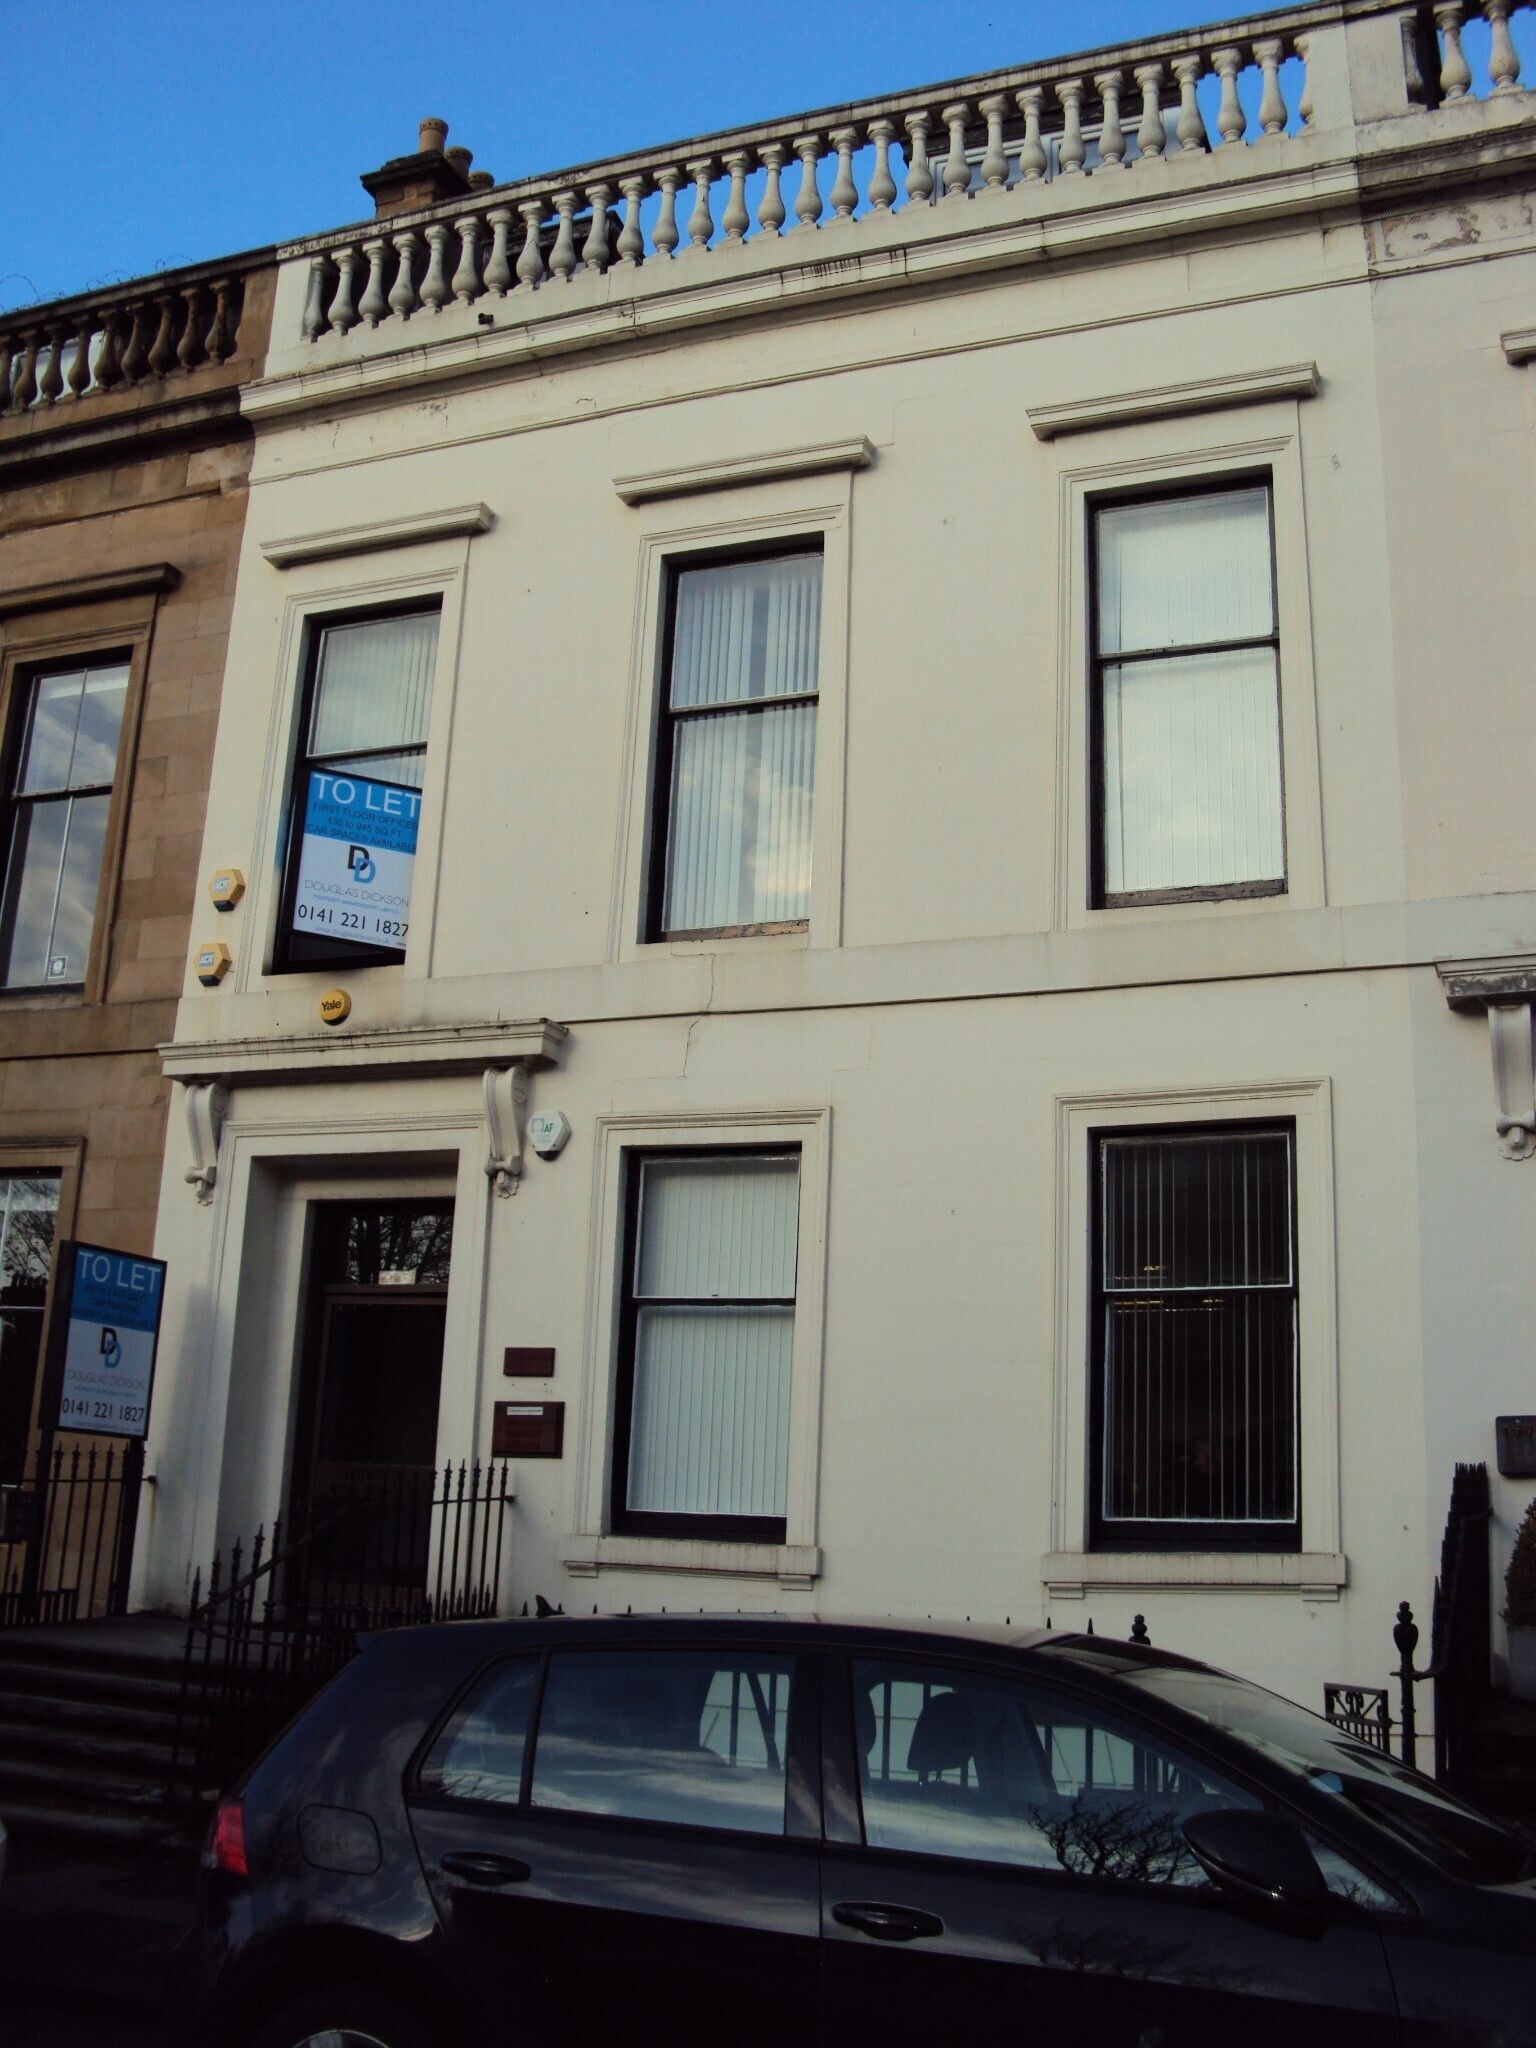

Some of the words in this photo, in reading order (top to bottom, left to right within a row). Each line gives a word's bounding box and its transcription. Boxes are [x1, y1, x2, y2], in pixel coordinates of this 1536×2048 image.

[313, 774, 356, 804] TO
[365, 785, 421, 818] LET
[312, 802, 340, 814] FIRST
[343, 808, 376, 820] FLOOR
[378, 815, 419, 831] OFFICES
[345, 820, 354, 828] to
[307, 823, 327, 834] CAR
[330, 828, 368, 843] SPACES
[370, 836, 417, 852] AVAILABLE
[304, 879, 359, 898] DOUGLAS
[362, 890, 409, 907] DICKSON
[298, 904, 333, 924] 0141
[340, 912, 366, 930] 221
[376, 918, 409, 937] 1827
[321, 1000, 342, 1011] Yale
[79, 1251, 111, 1283] TO
[117, 1260, 161, 1293] LET
[62, 1398, 89, 1415] 0141
[94, 1401, 113, 1419] 221
[120, 1405, 145, 1422] 1827
